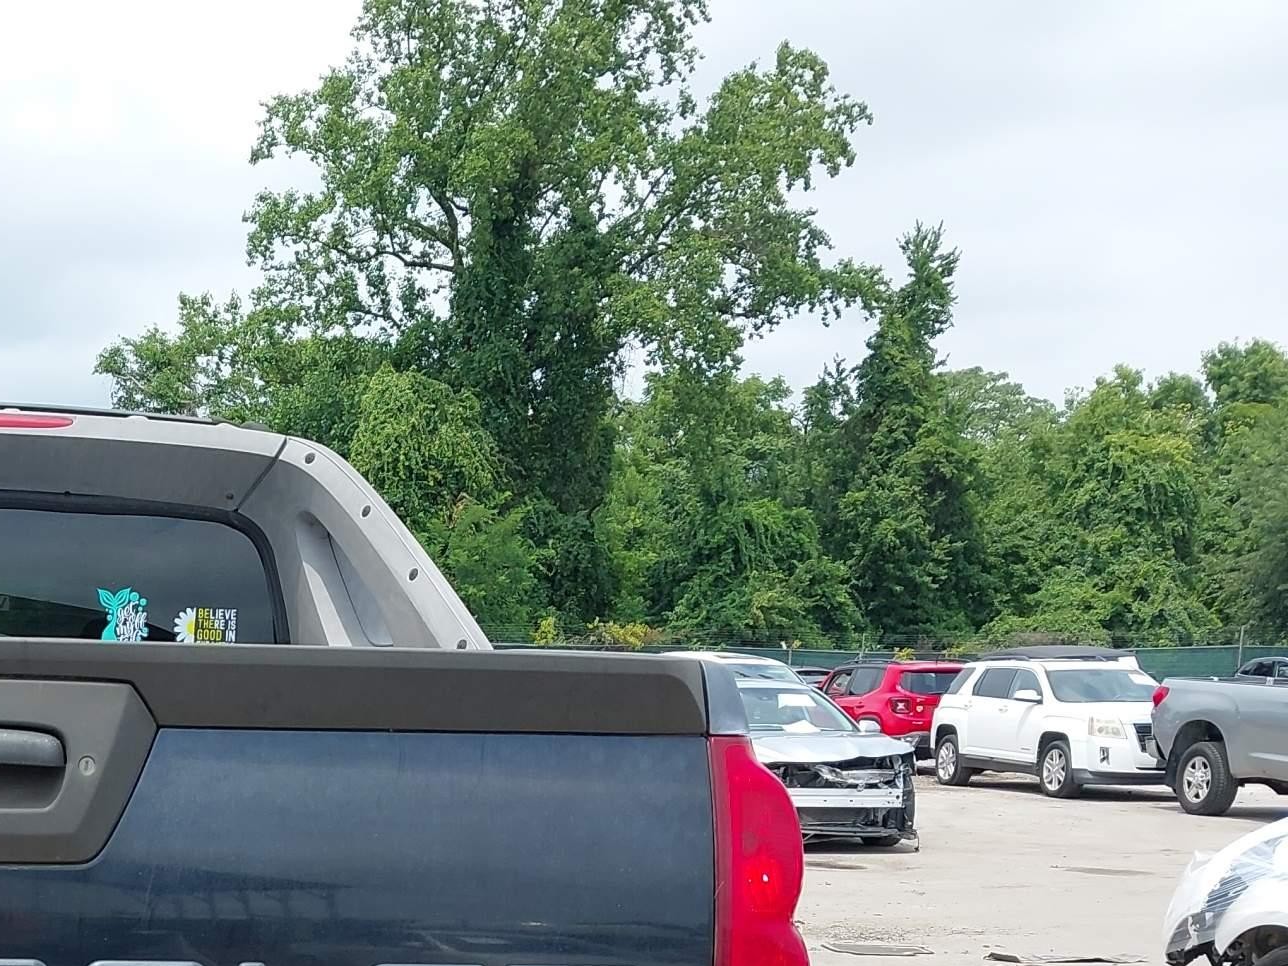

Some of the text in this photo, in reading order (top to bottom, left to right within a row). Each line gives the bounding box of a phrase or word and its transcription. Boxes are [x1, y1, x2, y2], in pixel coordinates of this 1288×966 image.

[117, 600, 139, 625] get
[198, 608, 237, 620] BELIEVE
[198, 619, 237, 630] THERE IS
[197, 629, 236, 642] GOOD IN
